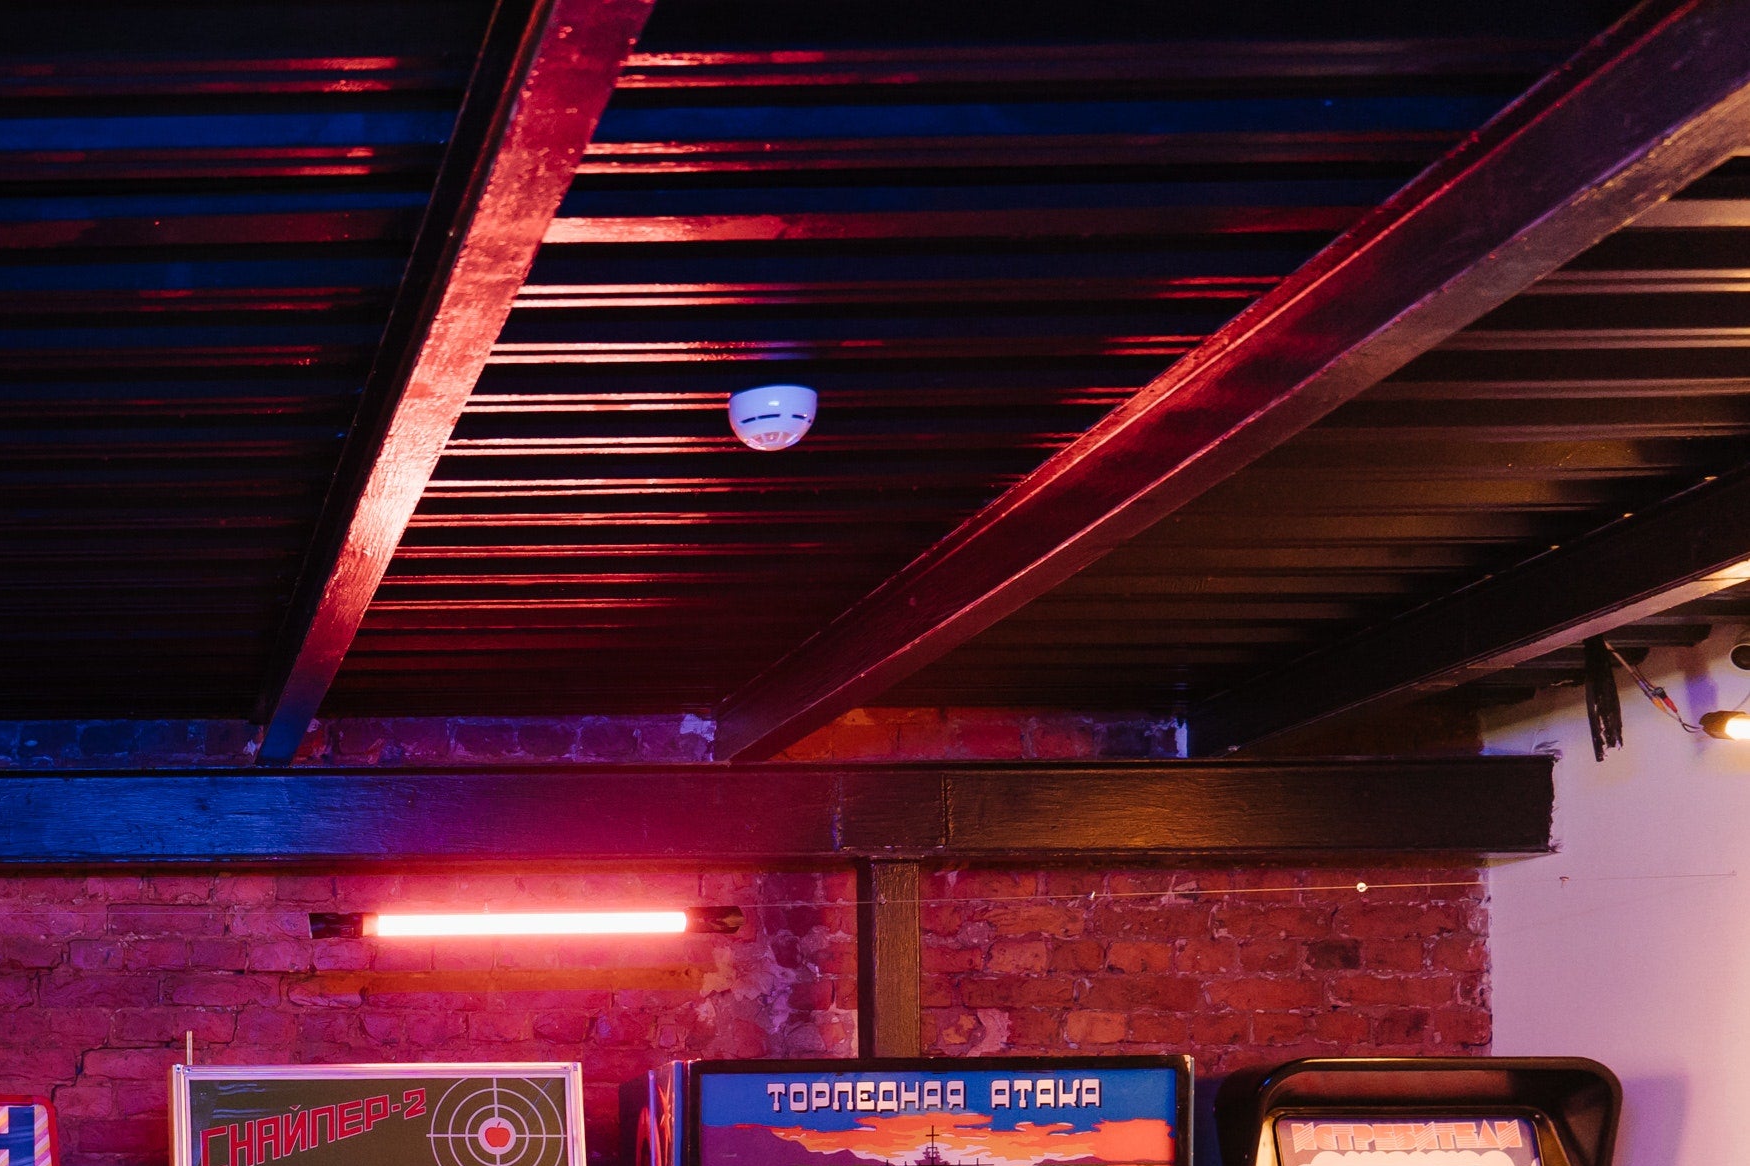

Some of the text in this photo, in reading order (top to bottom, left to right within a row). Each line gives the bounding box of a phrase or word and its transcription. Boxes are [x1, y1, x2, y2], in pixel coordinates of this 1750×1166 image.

[767, 1078, 1102, 1112] ТОРПЕДНАЯ АТАКА
[1291, 1119, 1523, 1153] ИСТРЕБИТЕЛИ
